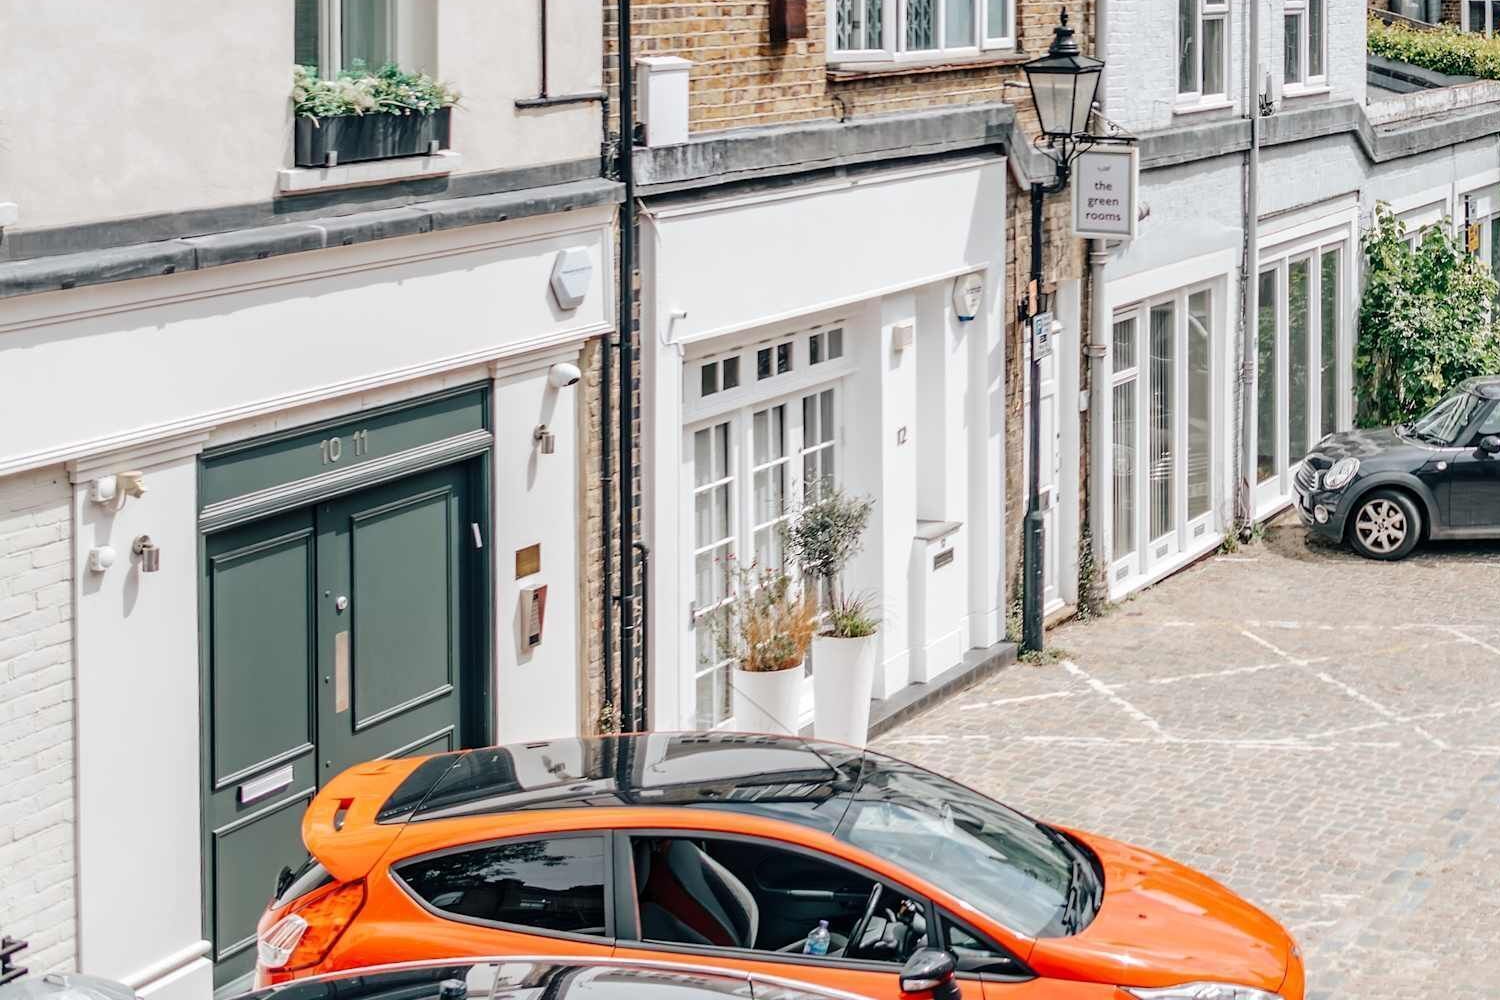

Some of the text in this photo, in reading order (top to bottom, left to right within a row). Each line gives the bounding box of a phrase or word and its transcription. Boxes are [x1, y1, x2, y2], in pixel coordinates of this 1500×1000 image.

[1094, 180, 1112, 191] the
[1087, 198, 1119, 207] green
[1085, 212, 1120, 221] rooms
[320, 429, 368, 464] 10 11
